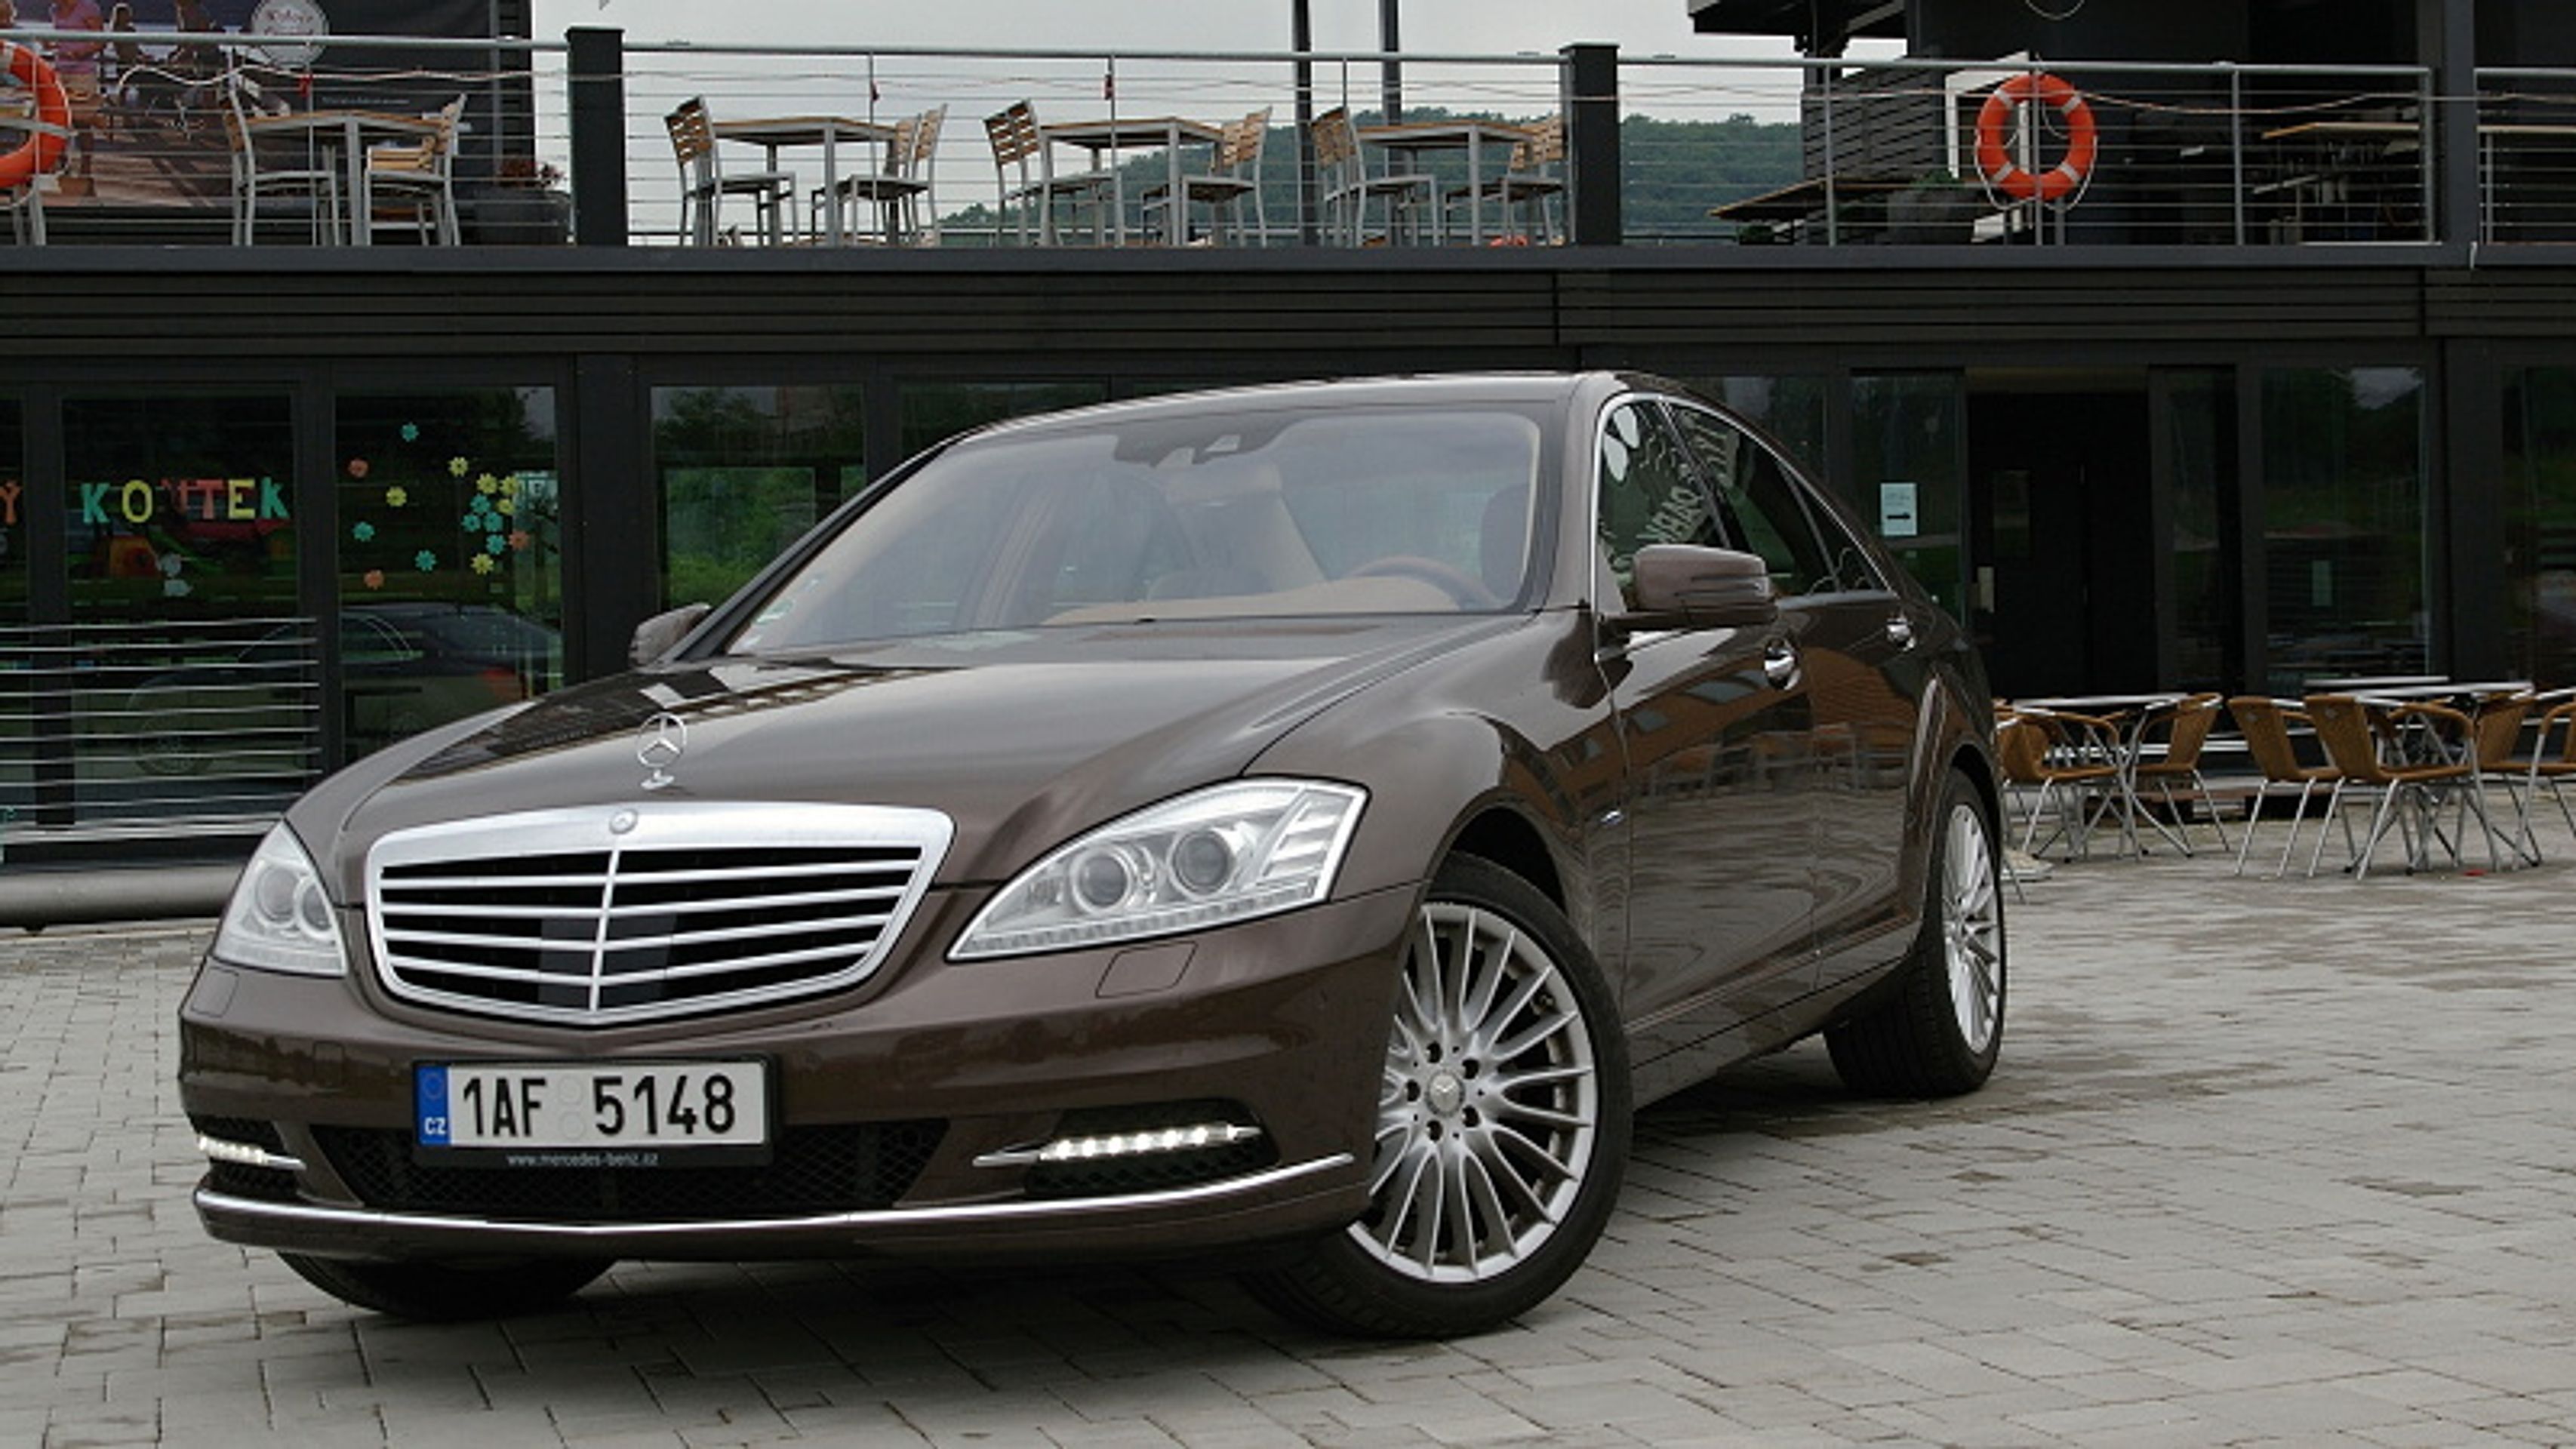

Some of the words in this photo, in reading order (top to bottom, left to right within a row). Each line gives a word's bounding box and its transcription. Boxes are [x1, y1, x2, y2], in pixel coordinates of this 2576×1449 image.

[463, 1077, 546, 1137] 1AF
[593, 1074, 736, 1136] 5148
[424, 1117, 447, 1135] CZ
[506, 1152, 659, 1167] www.mercedes-benz.cz
